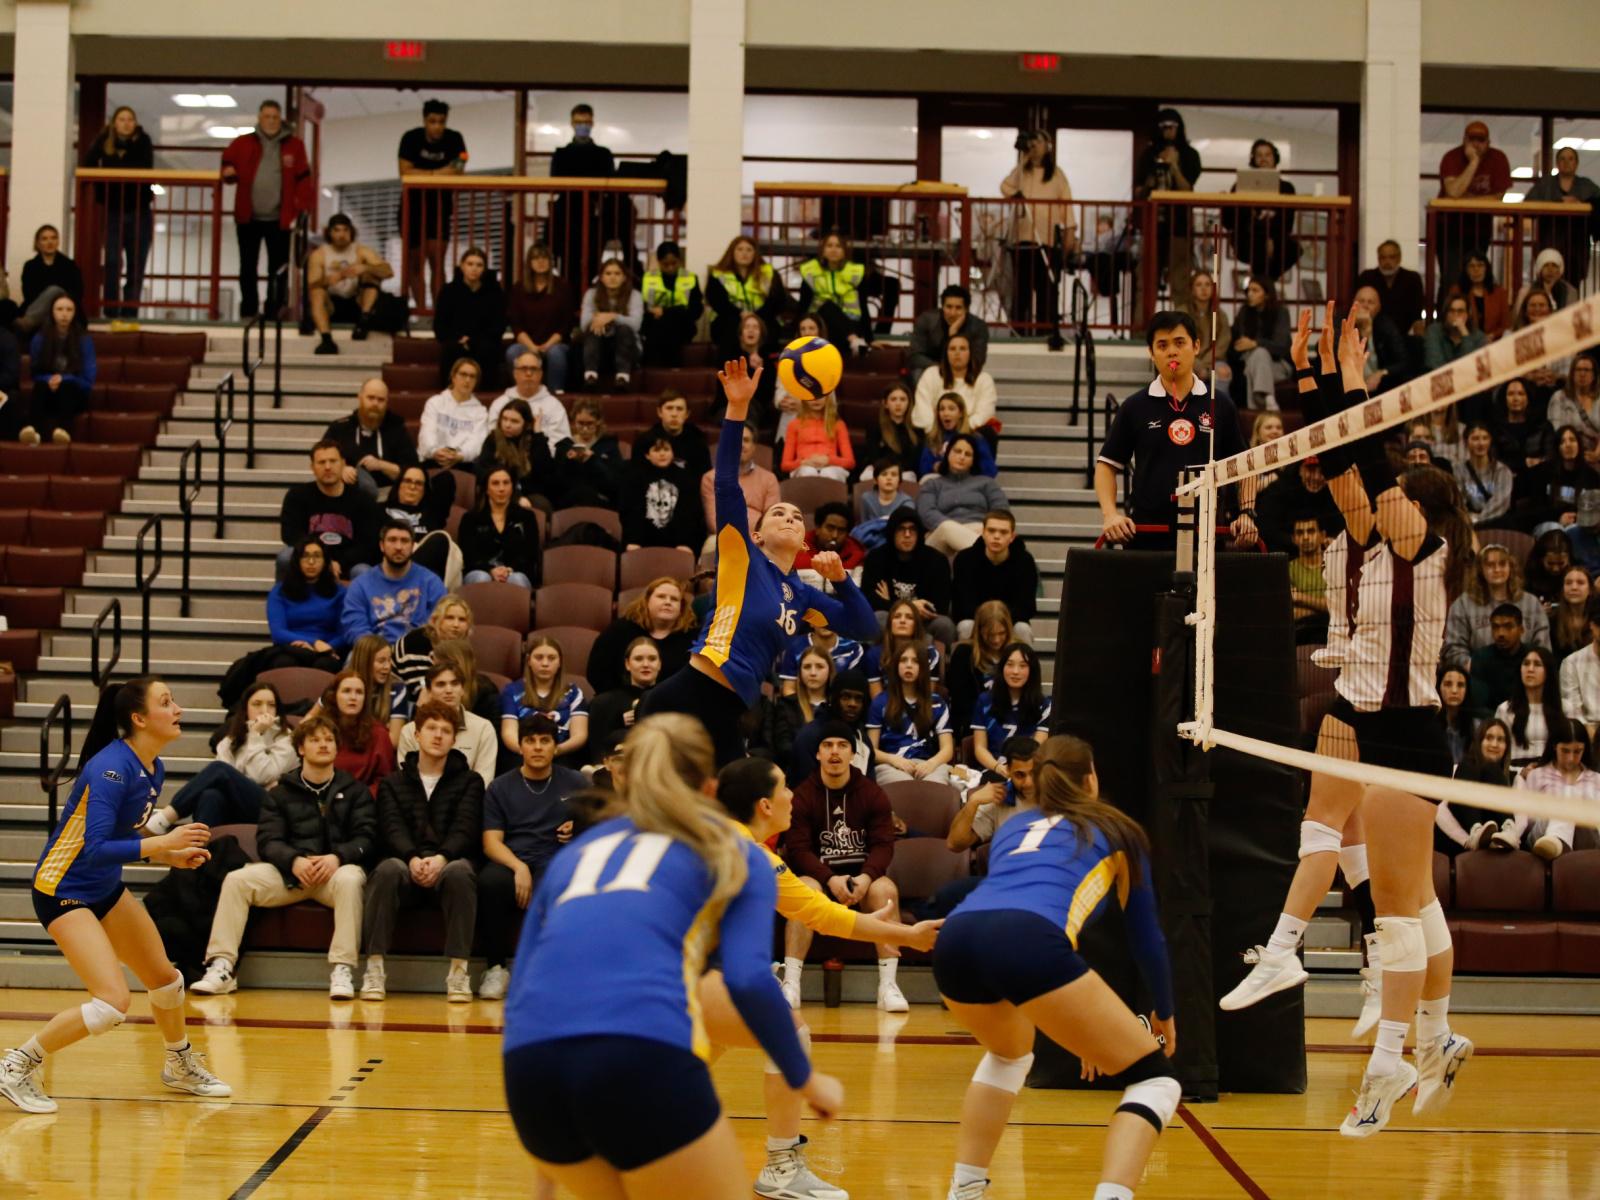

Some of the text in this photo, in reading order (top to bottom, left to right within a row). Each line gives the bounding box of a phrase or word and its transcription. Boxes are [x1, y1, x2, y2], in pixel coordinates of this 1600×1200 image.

[775, 602, 798, 636] 16
[819, 829, 866, 849] SMU
[1007, 813, 1066, 856] 1
[555, 829, 673, 904] 11
